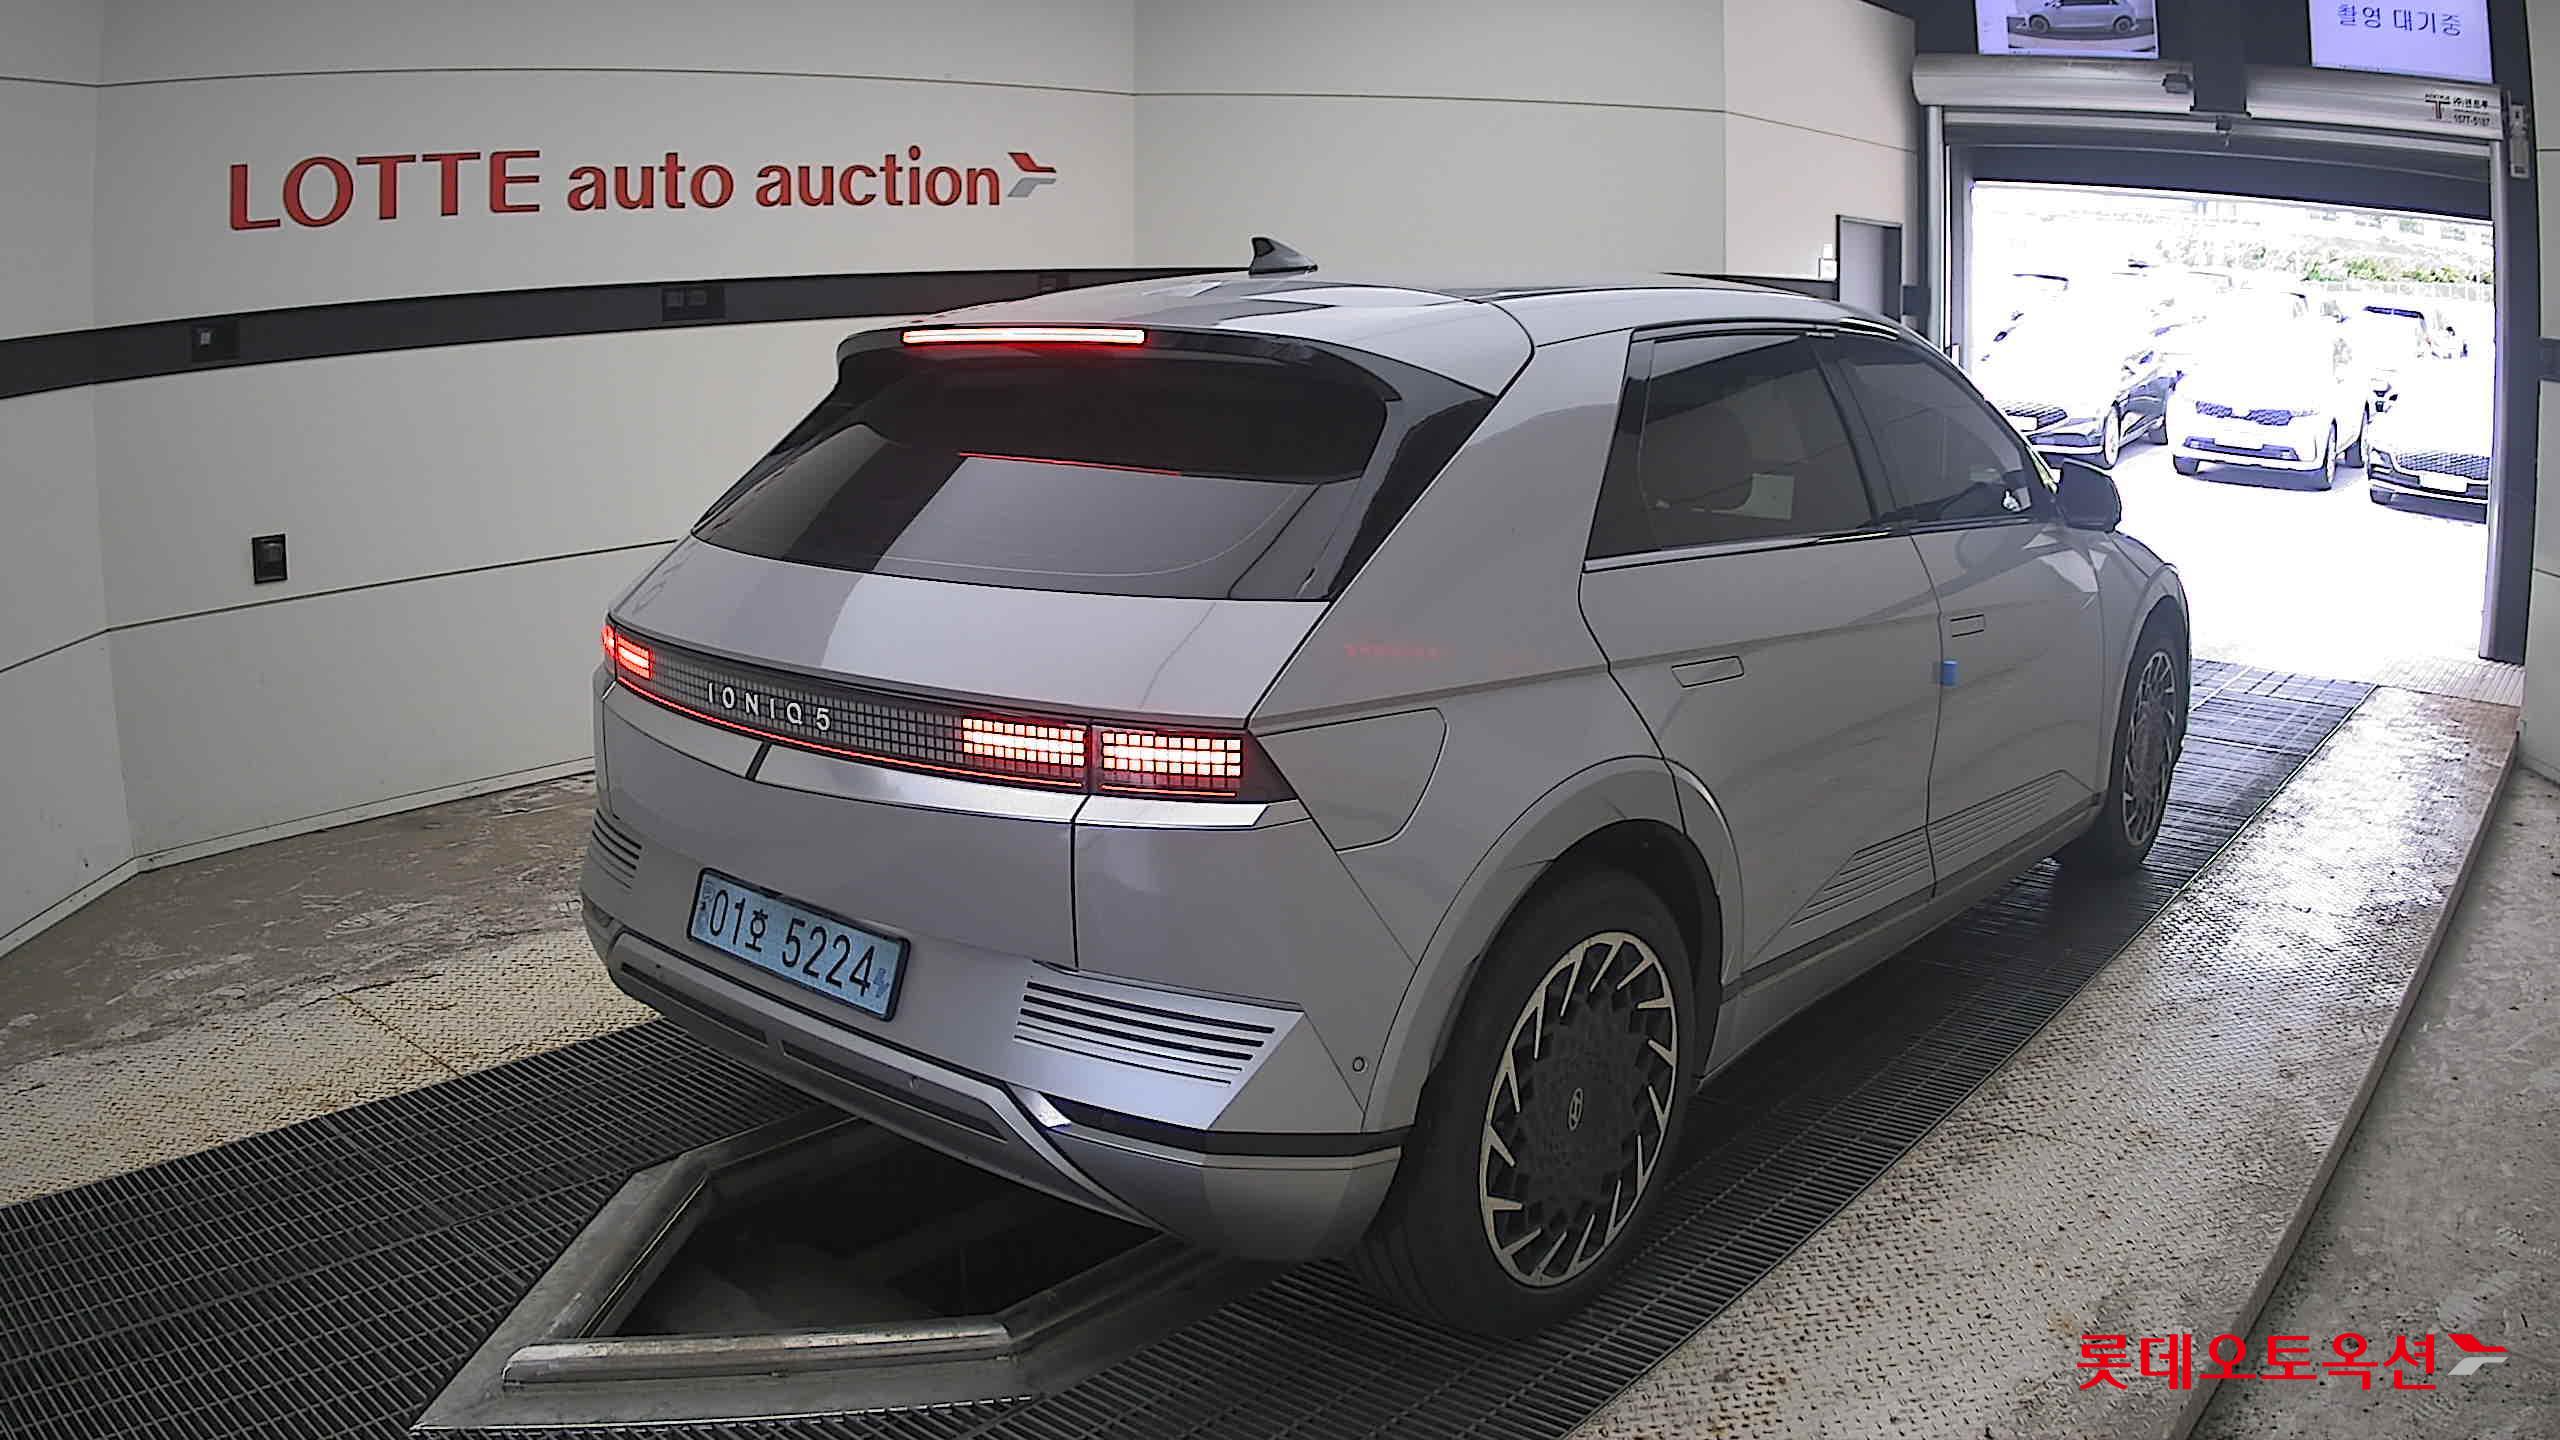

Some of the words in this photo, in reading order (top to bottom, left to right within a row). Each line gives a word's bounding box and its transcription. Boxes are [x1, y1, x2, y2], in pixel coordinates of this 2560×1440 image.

[2393, 8, 2461, 37] 대기중
[229, 149, 540, 231] LOTTE
[566, 152, 734, 210] auto
[754, 144, 1001, 207] auction
[708, 682, 802, 725] IONIQ
[816, 707, 830, 731] 5
[709, 889, 769, 953] 01호
[781, 917, 876, 997] 5224
